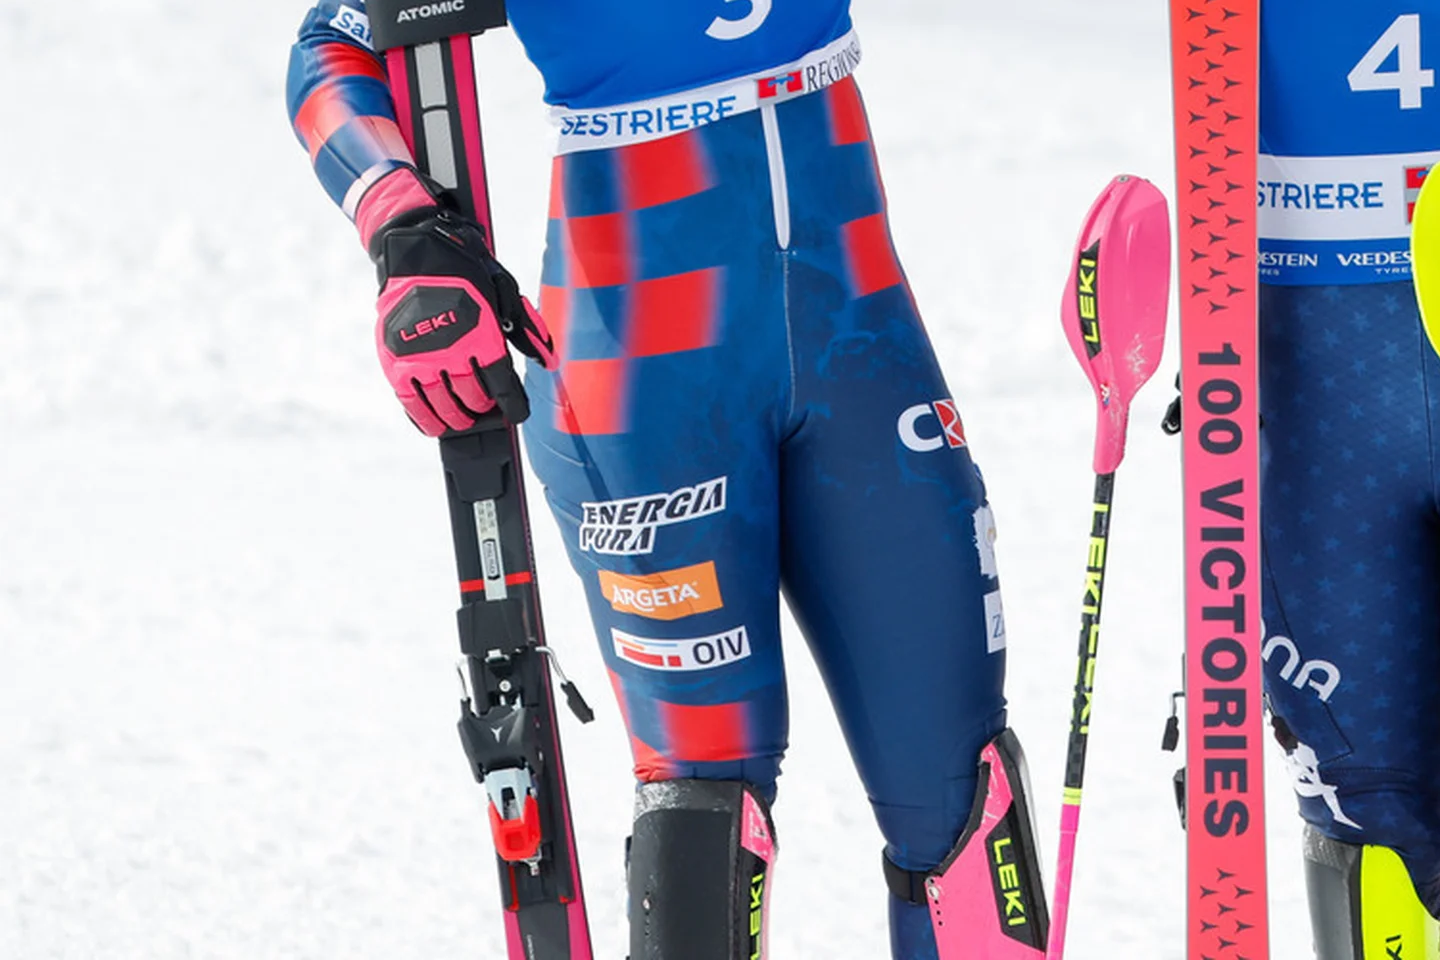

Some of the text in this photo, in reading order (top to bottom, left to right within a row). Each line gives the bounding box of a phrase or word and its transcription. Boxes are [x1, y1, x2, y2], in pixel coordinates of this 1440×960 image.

[1346, 13, 1435, 110] 4
[560, 95, 737, 136] SESTRIERE
[1257, 181, 1384, 210] STRIERE
[1078, 258, 1100, 345] LEKI
[400, 309, 457, 342] LEKI
[586, 481, 724, 526] ENERGIA
[582, 526, 652, 552] PURA
[612, 582, 701, 612] ARGETA
[1196, 341, 1250, 838] 100 VICTORIES
[692, 630, 744, 666] OIV
[991, 836, 1026, 928] LEKI
